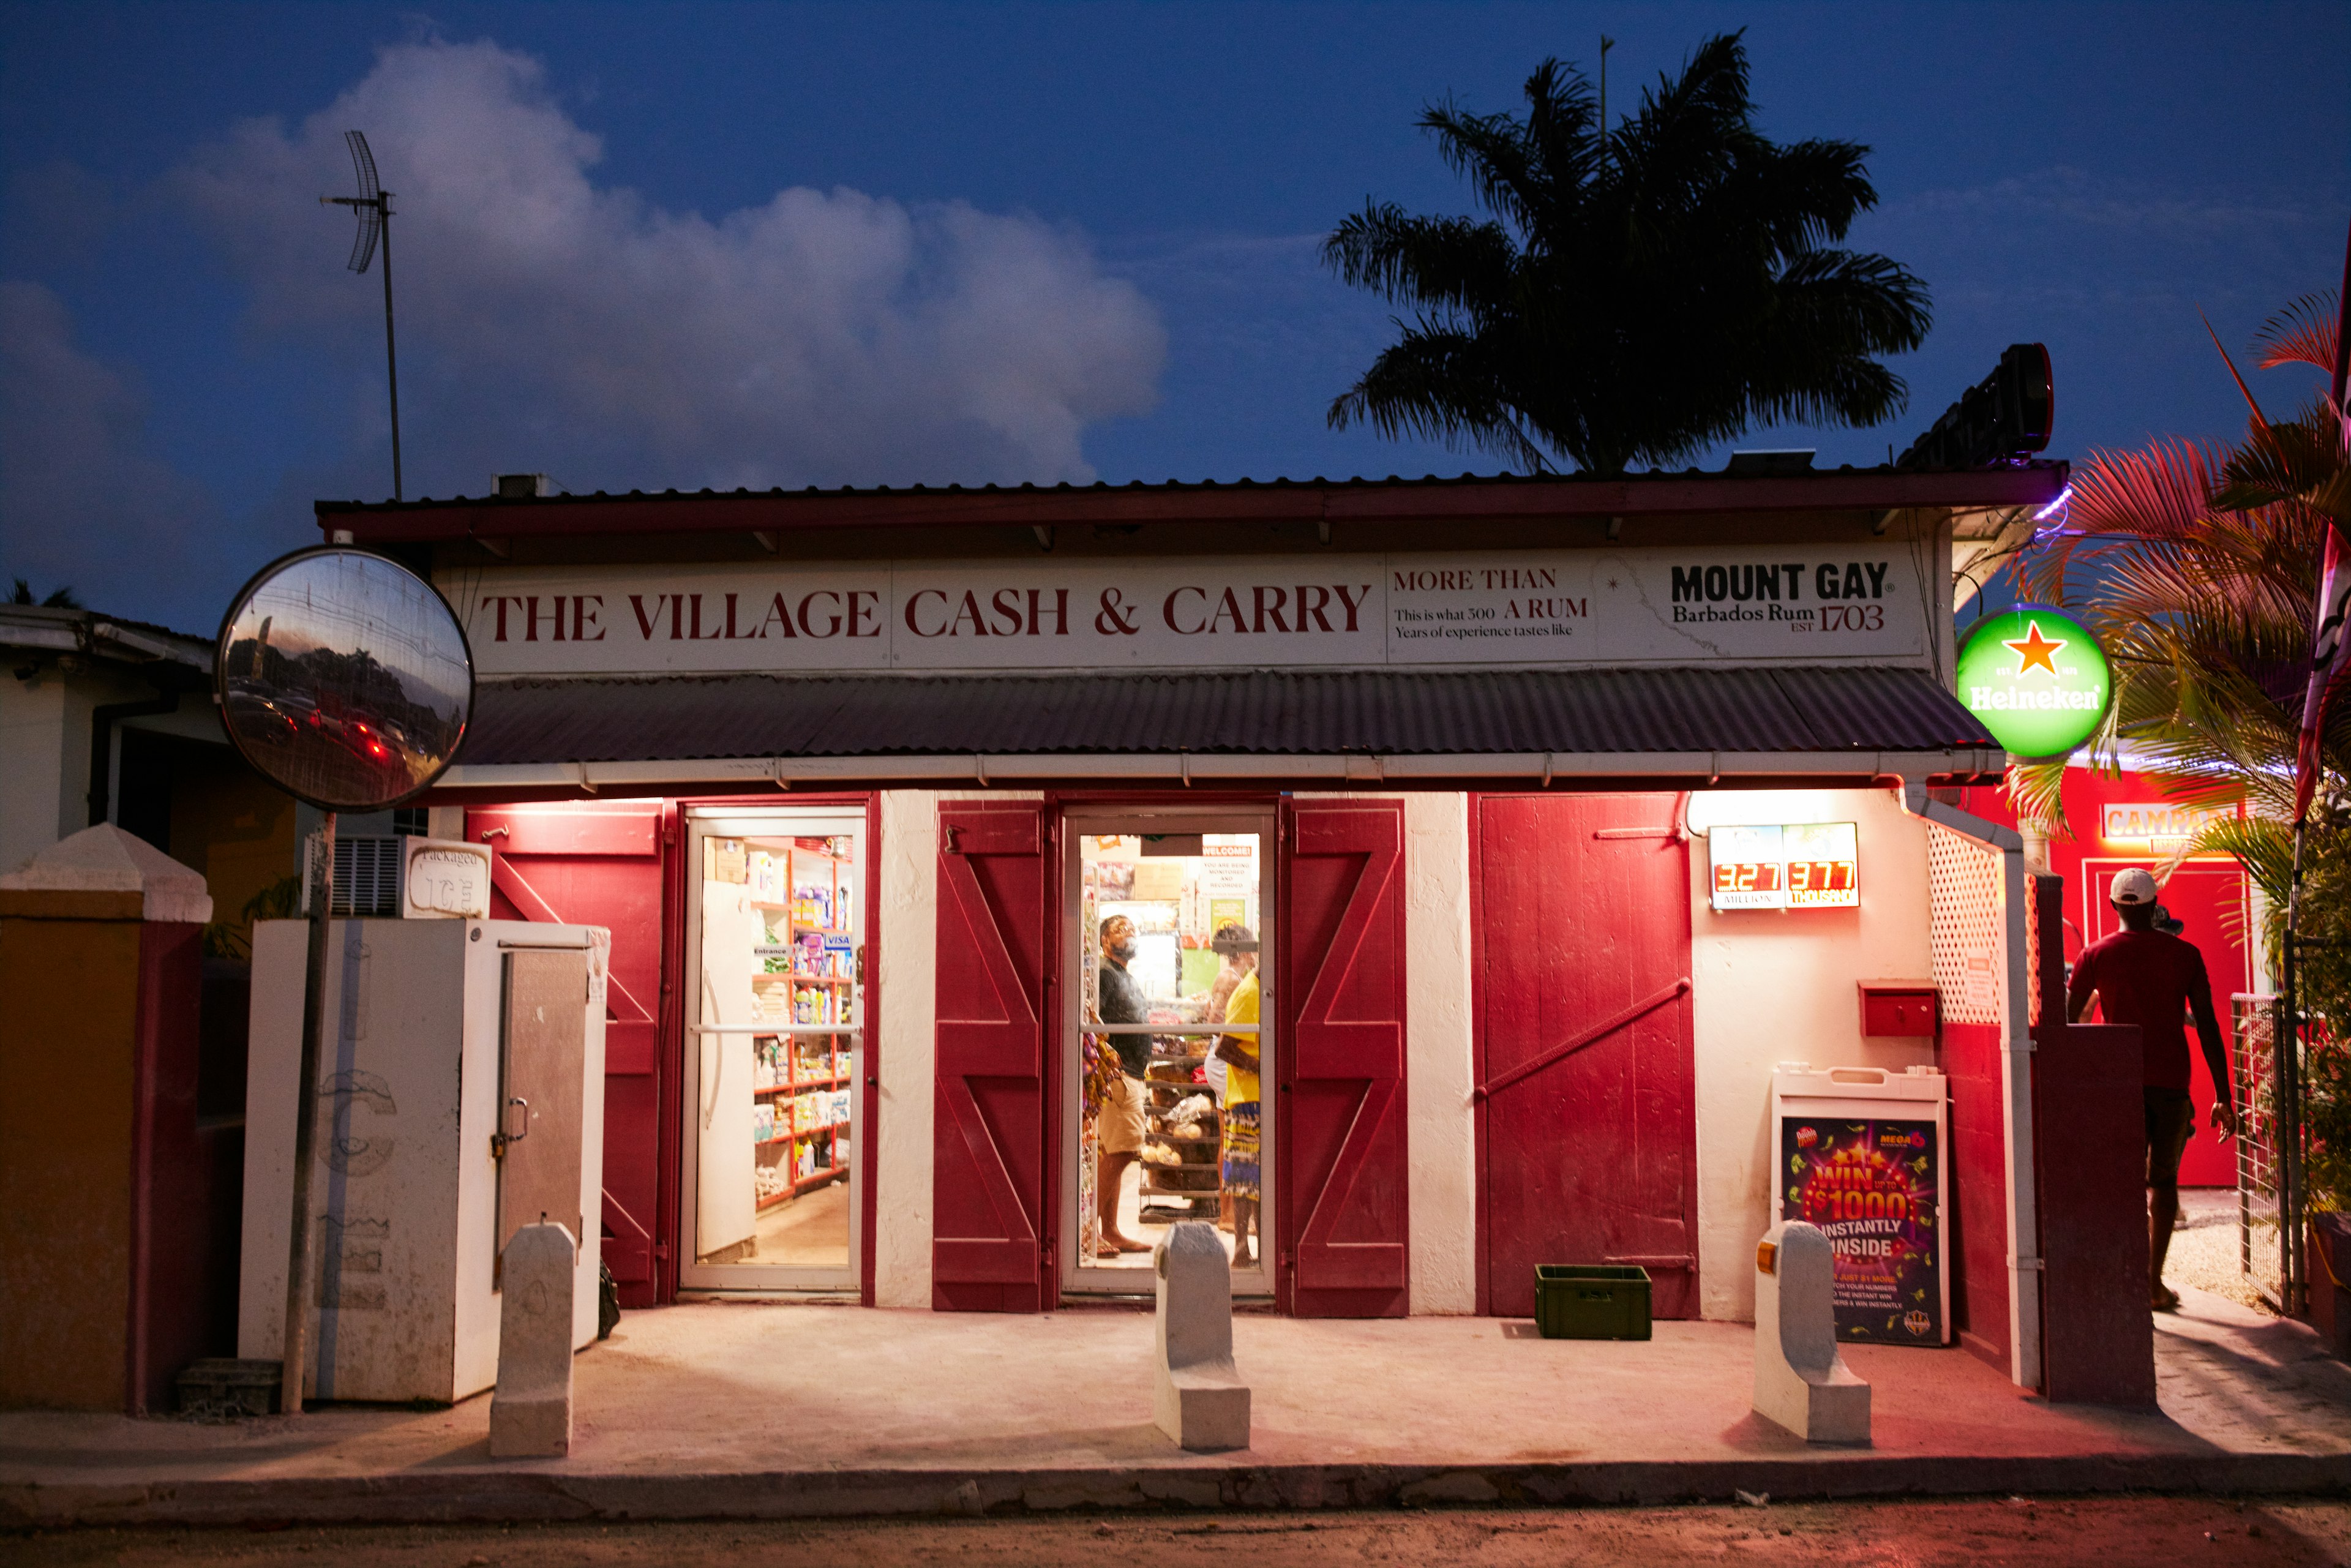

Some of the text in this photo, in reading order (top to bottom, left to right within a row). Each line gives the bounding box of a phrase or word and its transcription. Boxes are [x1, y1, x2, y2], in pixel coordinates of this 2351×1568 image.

[1393, 568, 1556, 592] MORE THAN
[1671, 563, 1805, 602] MOUNT
[481, 584, 1372, 642] THE VILLAGE CASH & CARRY
[1394, 607, 1495, 621] This is what 300
[1504, 598, 1588, 619] A RUM
[1672, 603, 1815, 623] Barbados Rum
[1791, 604, 1884, 632] EST 1703
[1395, 623, 1572, 640] Years of experience tastes like
[422, 850, 478, 867] Packaged
[1202, 846, 1251, 856] WELCOME!
[1790, 861, 1854, 890] 377
[1724, 889, 1854, 904] MILLION THOUSAND
[1880, 1135, 1911, 1144] MEGA
[1815, 1166, 1897, 1190] WIN UP TO
[1813, 1190, 1907, 1220] $1000
[1821, 1219, 1902, 1237] INSTANTLY
[1831, 1238, 1892, 1257] INSIDE
